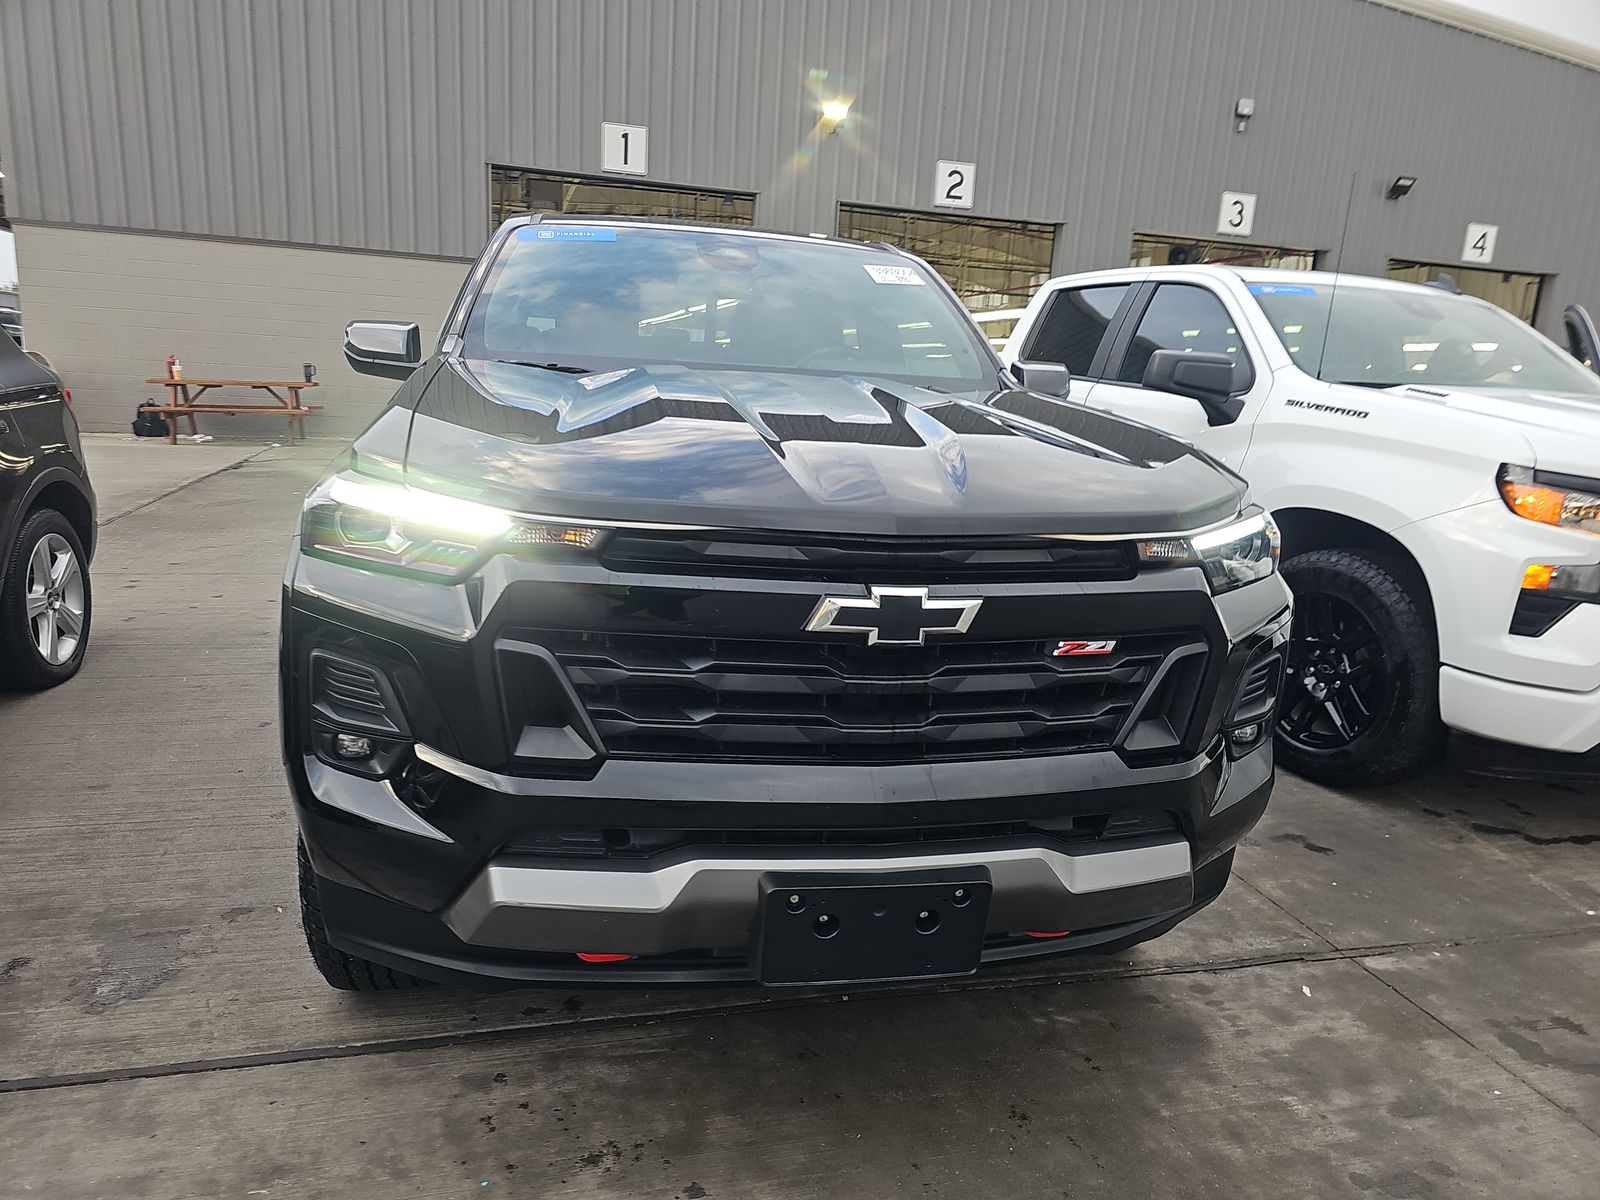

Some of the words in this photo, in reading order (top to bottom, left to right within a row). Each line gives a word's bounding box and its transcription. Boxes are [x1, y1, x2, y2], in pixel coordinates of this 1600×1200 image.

[621, 132, 629, 166] 1
[945, 169, 964, 200] 2
[1229, 200, 1244, 228] 3
[1472, 231, 1488, 257] 4
[1285, 399, 1370, 419] SILVERADO
